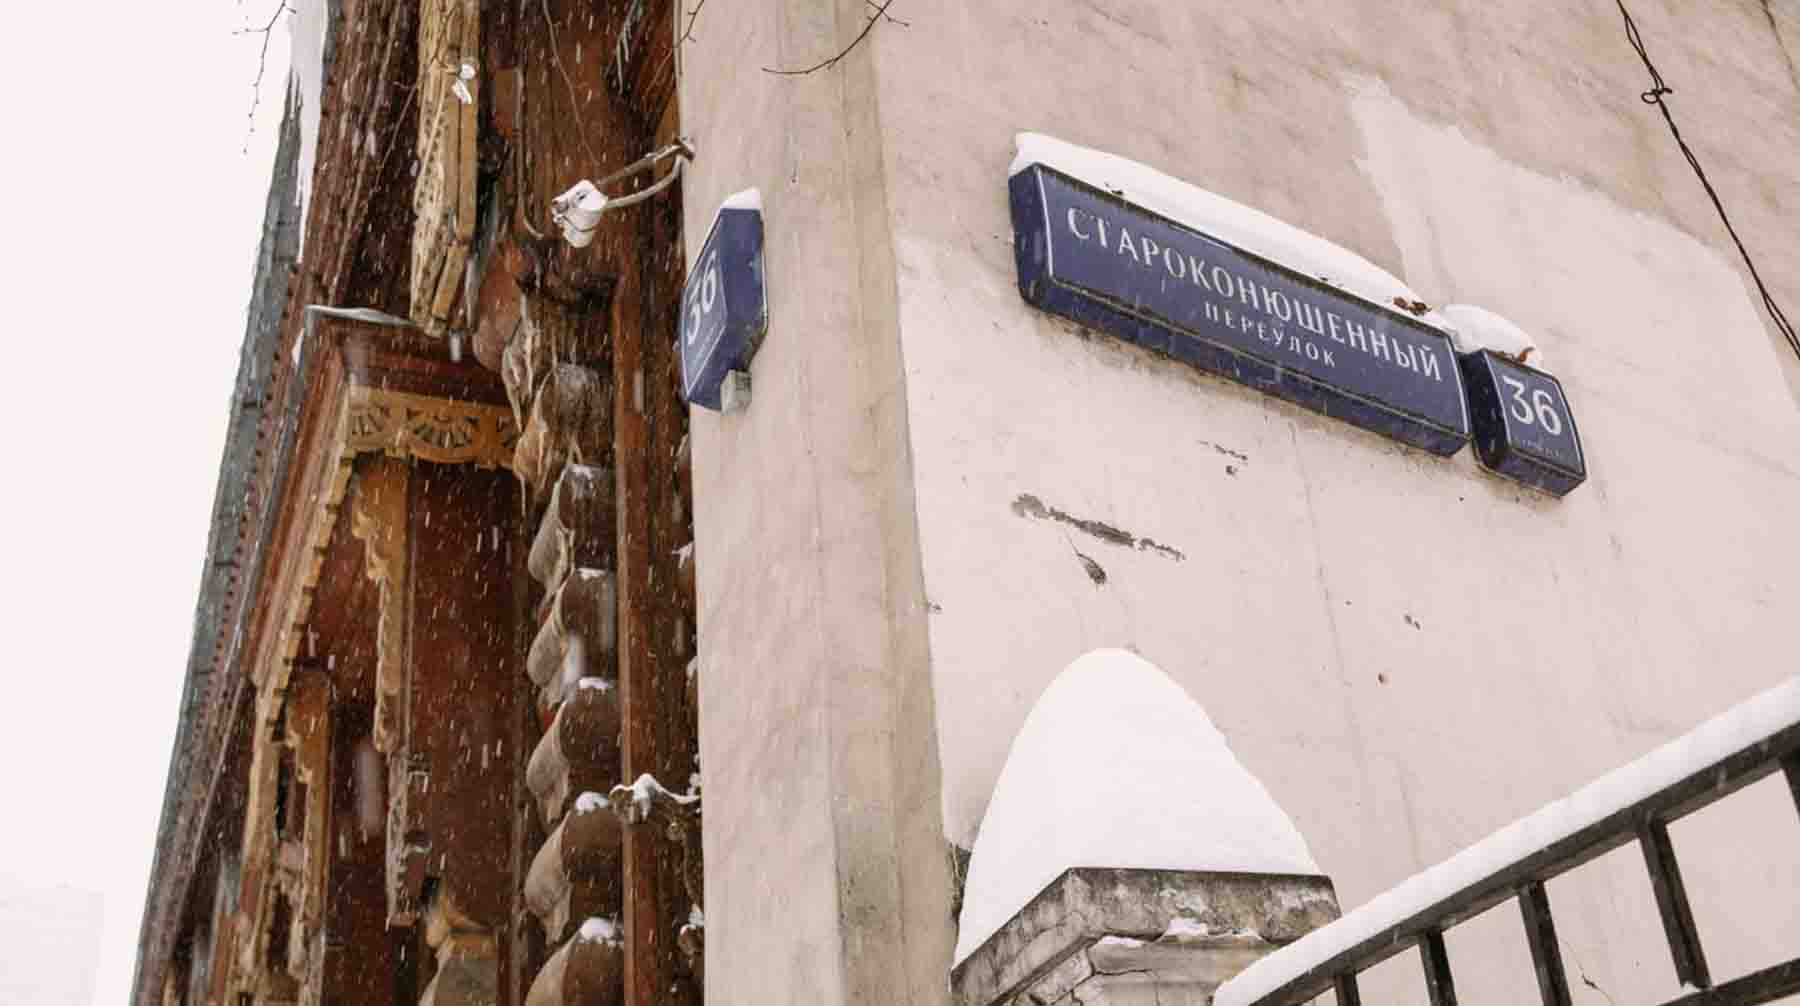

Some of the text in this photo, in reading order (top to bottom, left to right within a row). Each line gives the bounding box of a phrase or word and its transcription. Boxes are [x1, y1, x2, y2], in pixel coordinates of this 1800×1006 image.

[686, 248, 717, 347] 36
[1067, 207, 1442, 382] СТАРОКОНЮШЕННЫЙ
[1205, 301, 1336, 368] ПЕРЕУЛОК
[1502, 375, 1562, 436] 36
